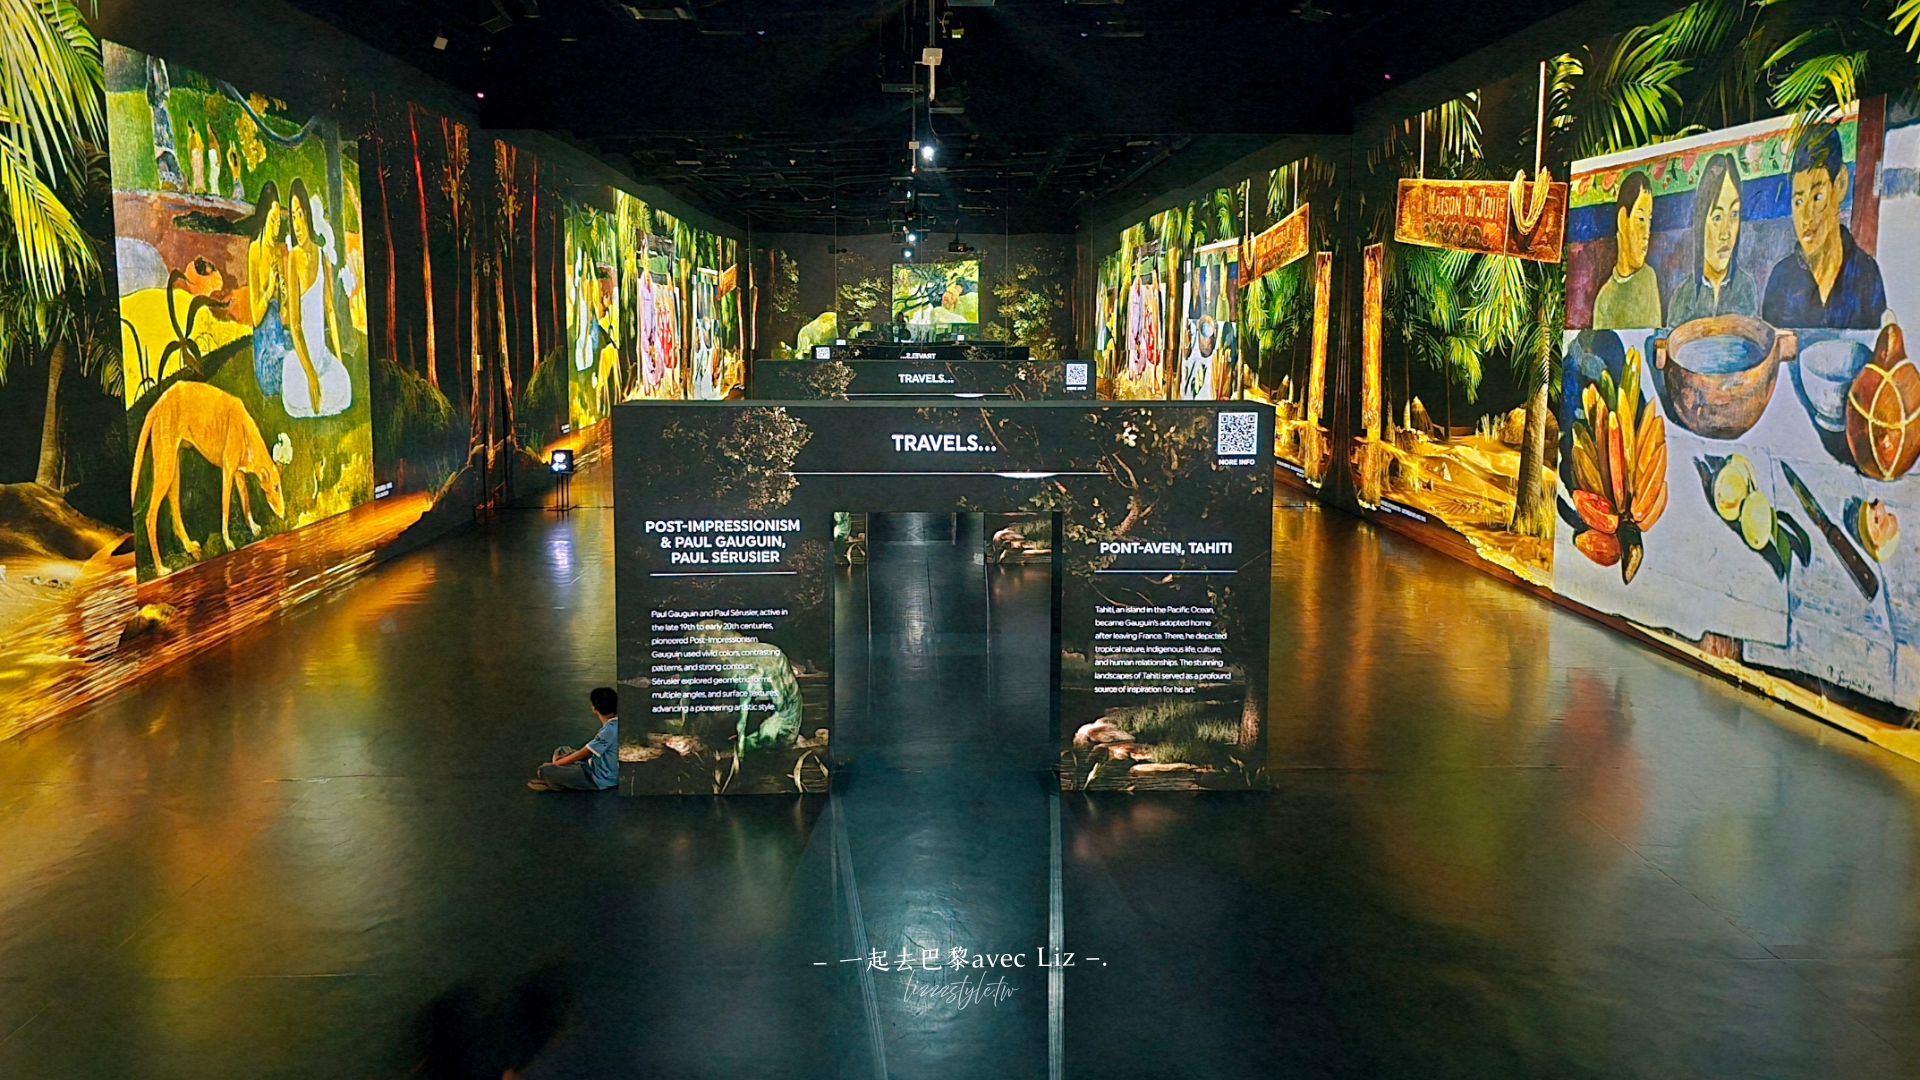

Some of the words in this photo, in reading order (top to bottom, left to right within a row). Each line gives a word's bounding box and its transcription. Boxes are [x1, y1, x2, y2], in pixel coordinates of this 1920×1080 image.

[898, 373, 955, 384] TRAVELS...
[892, 434, 997, 452] TRAVELS...
[645, 519, 800, 533] POST-IMPRESSIONISM
[660, 537, 672, 548] &
[675, 536, 712, 548] PAUL
[715, 535, 786, 549] GAUGUIN,
[1100, 542, 1186, 556] PONT-AVEN,
[1188, 542, 1232, 554] TAHITI
[671, 552, 709, 564] PAUL
[711, 549, 780, 563] SÉRUSIER
[651, 610, 667, 618] Paul
[668, 610, 699, 619] Gauguin
[714, 609, 730, 617] Paul
[760, 608, 780, 616] active
[781, 608, 789, 616] in
[1095, 606, 1116, 614] Tahiti,
[1126, 606, 1146, 614] island
[1146, 606, 1154, 614] in
[1154, 606, 1166, 614] the
[1167, 606, 1190, 614] Pacific
[1191, 606, 1215, 614] Ocean,
[652, 623, 665, 632] the
[665, 623, 679, 632] late
[680, 623, 696, 631] 19th
[696, 623, 705, 631] to
[705, 622, 722, 631] early
[723, 622, 740, 630] 20th
[740, 621, 774, 630] centuries,
[1095, 619, 1124, 627] became
[1160, 619, 1190, 627] adopted
[1191, 619, 1212, 627] home
[651, 637, 689, 646] pioneered
[1095, 632, 1112, 640] after
[1113, 632, 1138, 641] leaving
[1185, 632, 1196, 640] he
[1196, 632, 1228, 641] depicted
[651, 651, 682, 660] Gauguin
[684, 650, 701, 658] used
[702, 650, 718, 658] vivid
[741, 649, 780, 657] contrasting
[1095, 645, 1121, 653] tropical
[1146, 645, 1184, 655] indigenous
[651, 664, 683, 673] patterns,
[699, 664, 722, 672] strong
[1179, 659, 1193, 667] The
[1194, 659, 1223, 668] stunning
[681, 677, 713, 686] explored
[1094, 672, 1133, 681] landscapes
[1134, 672, 1142, 680] of
[1143, 672, 1161, 680] Tahiti
[1161, 672, 1185, 680] served
[1199, 672, 1232, 682] profound
[652, 691, 682, 699] multiple
[683, 690, 707, 700] angles,
[708, 690, 722, 698] and
[722, 689, 748, 698] surface
[1127, 686, 1162, 694] inspiration
[652, 705, 689, 714] advancing
[695, 704, 734, 714] pioneering
[735, 704, 757, 712] artistic
